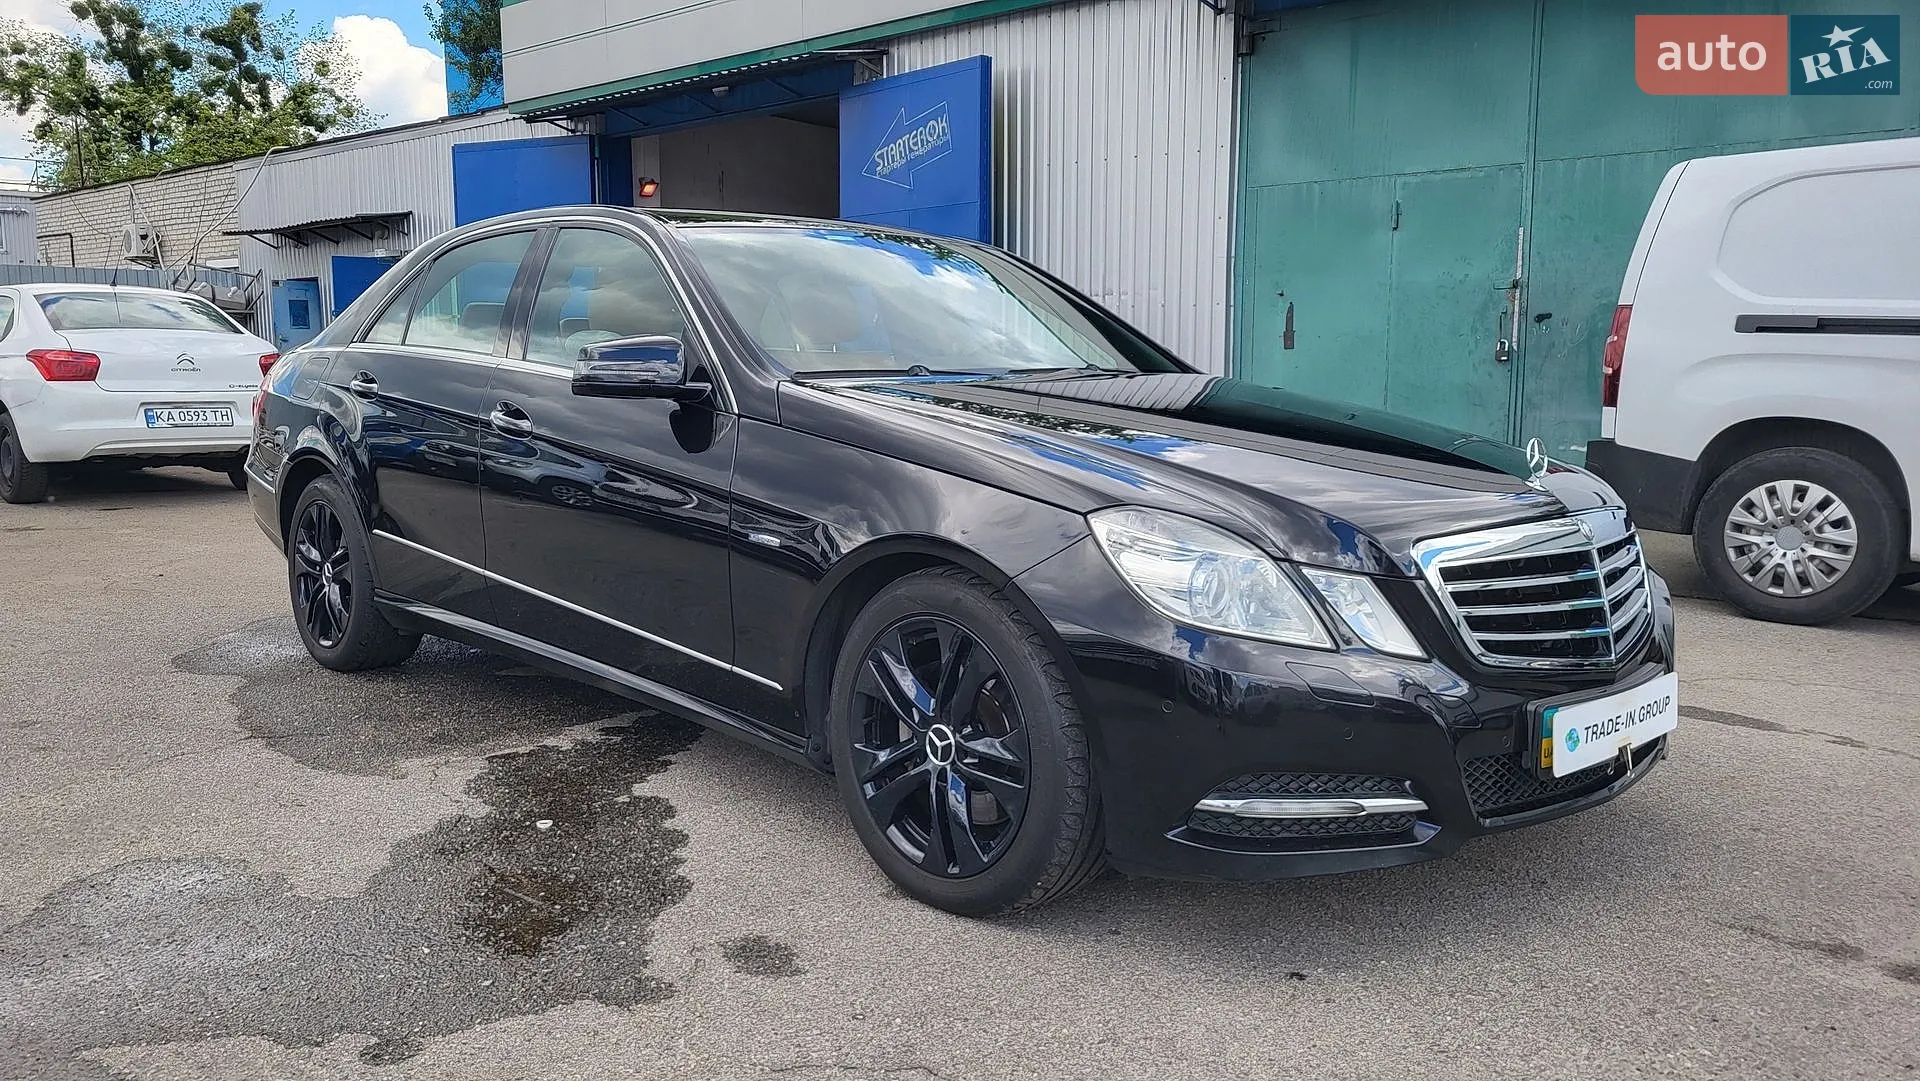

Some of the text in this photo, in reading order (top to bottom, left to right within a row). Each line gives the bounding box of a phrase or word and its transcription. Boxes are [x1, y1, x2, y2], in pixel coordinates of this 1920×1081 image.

[155, 405, 230, 422] KA 0593 TH
